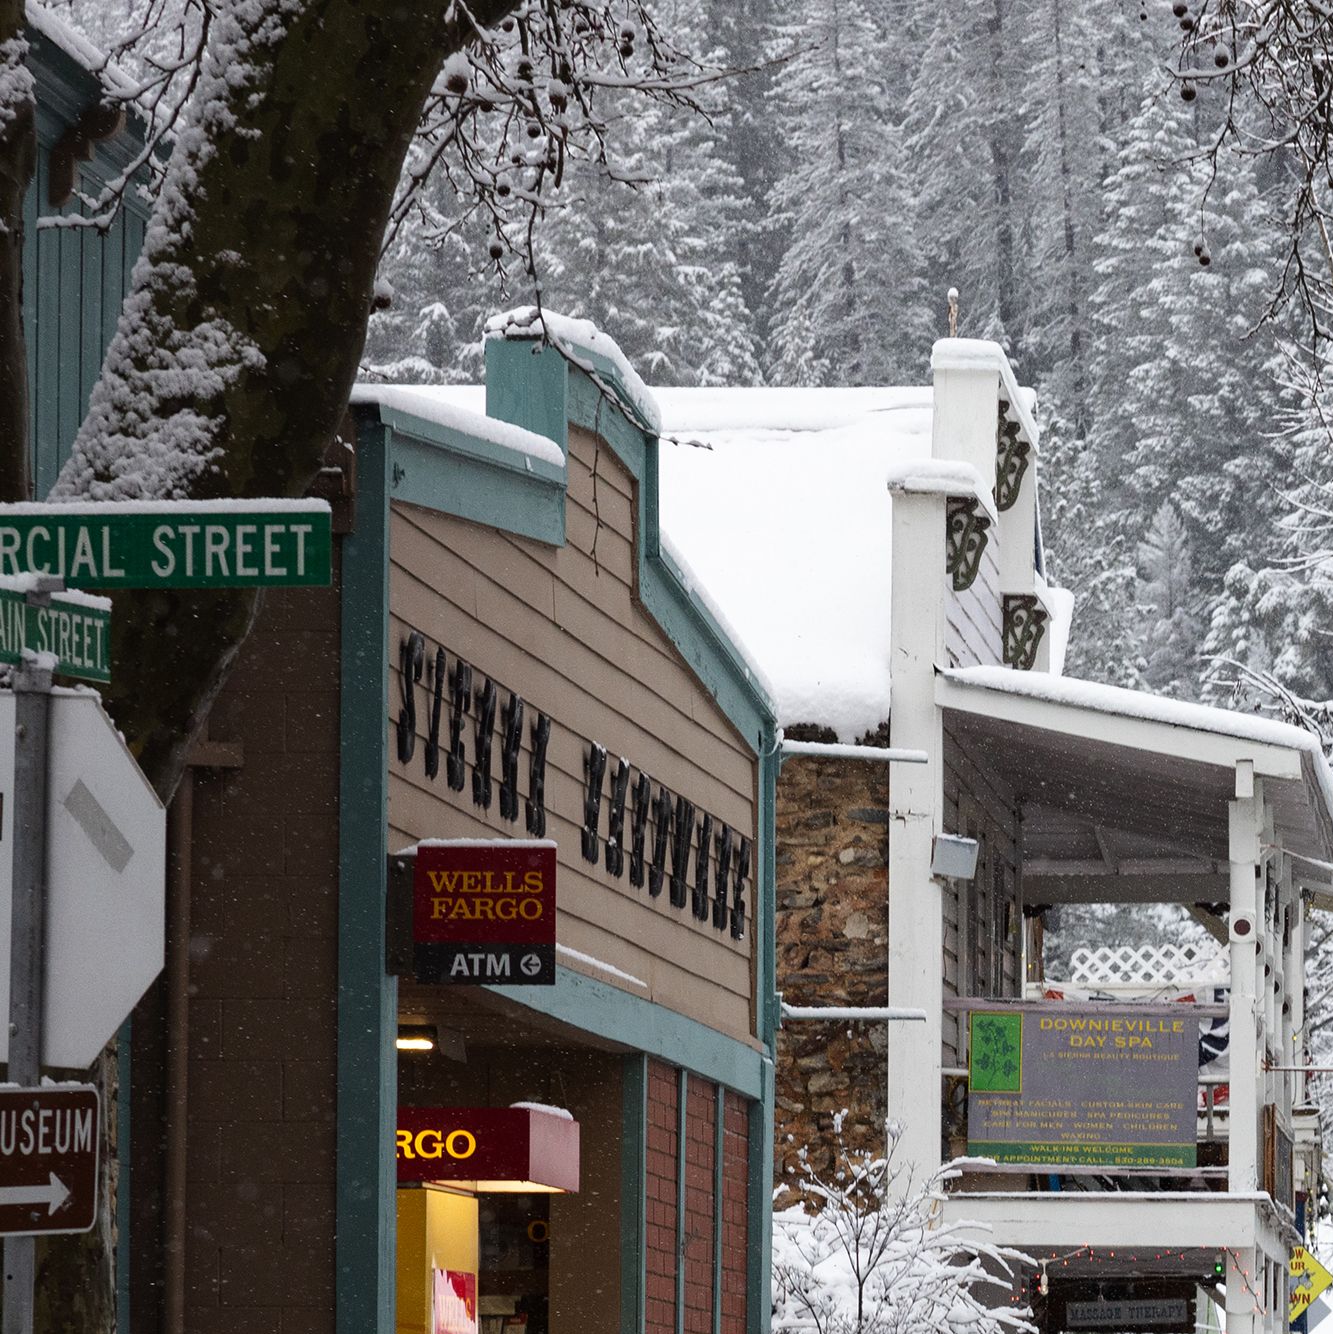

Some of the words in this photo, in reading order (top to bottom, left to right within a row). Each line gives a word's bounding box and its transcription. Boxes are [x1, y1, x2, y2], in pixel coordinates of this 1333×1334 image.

[151, 524, 313, 577] STREET
[37, 607, 104, 670] STREET
[427, 870, 544, 894] WELLS
[430, 897, 543, 920] FARGO
[450, 953, 511, 977] ATM
[1040, 1018, 1185, 1033] DOWNIEVILLE
[1070, 1035, 1106, 1048] DAY
[1114, 1036, 1153, 1048] SPA
[1093, 1052, 1130, 1060] BEAUTY
[1132, 1053, 1180, 1061] BOUTIQUE
[1073, 1122, 1114, 1130] WOMEN
[1123, 1123, 1179, 1131] CHILDREN
[1060, 1131, 1101, 1139] WAXING
[1082, 1145, 1134, 1154] WELCOME
[1003, 1155, 1076, 1164] APPOINTMENT
[1070, 1307, 1122, 1321] MASSAGE
[1128, 1305, 1184, 1320] THERAPY
